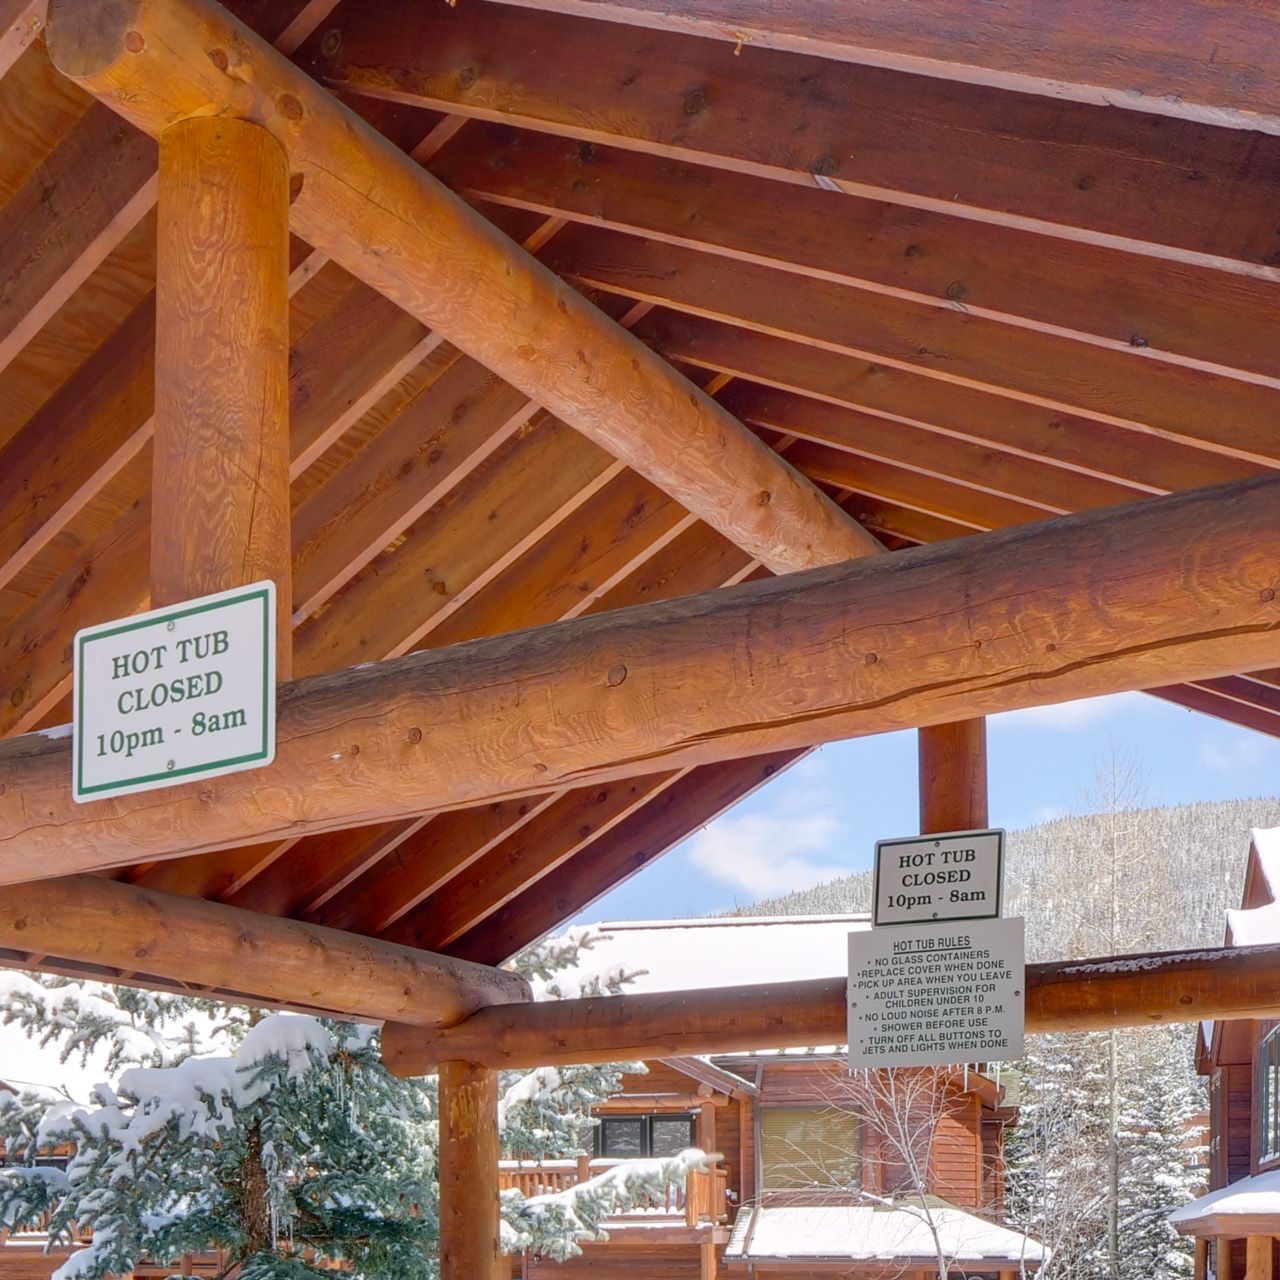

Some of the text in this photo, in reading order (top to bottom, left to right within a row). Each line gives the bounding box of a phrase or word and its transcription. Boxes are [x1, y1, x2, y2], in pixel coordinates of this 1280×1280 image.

[112, 630, 229, 680] HOT TUB
[118, 670, 223, 714] CLOSED
[97, 726, 164, 757] 10pm
[192, 708, 247, 736] 8am
[899, 850, 976, 868] HOT TUB
[902, 869, 971, 887] CLOSED
[887, 894, 932, 909] 10pm
[949, 890, 986, 902] 8am
[894, 936, 970, 951] HOT TUB RULES
[875, 950, 990, 966] NO GLASS CONTAINERS
[862, 960, 1004, 978] REPLACE COVER WHEN DONE
[858, 971, 1012, 989] PICK UP AREA WHEN YOU LEAVE
[874, 984, 996, 999] ADULT SUPERVISION FOR
[885, 995, 984, 1008] CHILDREN UNDER 10
[865, 1013, 878, 1021] NO
[882, 1012, 907, 1020] LOUD
[910, 1010, 938, 1019] NOISE
[942, 1007, 973, 1016] AFTER
[977, 1007, 982, 1015] 8
[882, 1018, 988, 1031] SHOWER BEFORE USE
[869, 1030, 1002, 1045] TURN OFF ALL BUTTONS TO
[863, 1039, 1008, 1055] JETS AND LIGHTS WHEN DONE
